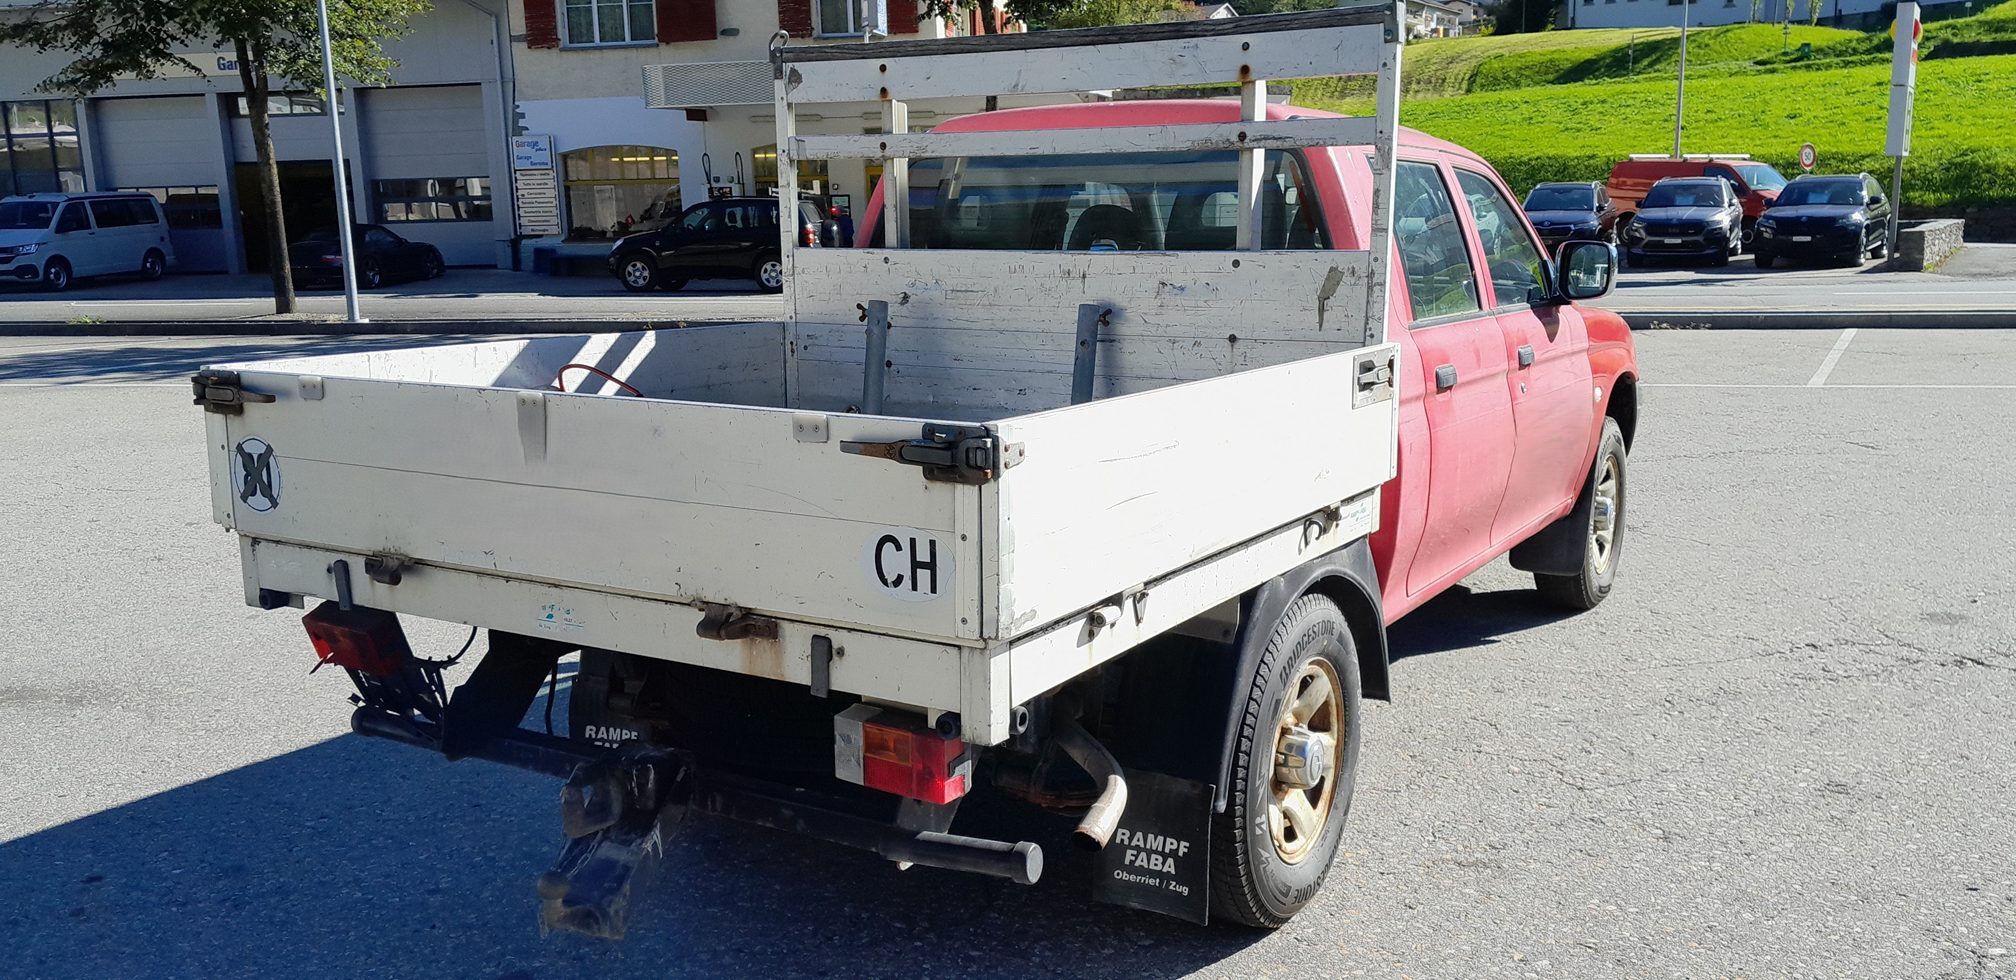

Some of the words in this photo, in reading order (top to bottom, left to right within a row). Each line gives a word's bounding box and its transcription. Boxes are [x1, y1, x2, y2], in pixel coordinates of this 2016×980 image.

[515, 140, 540, 149] Garage
[874, 534, 937, 595] CH
[1279, 620, 1336, 689] BRIDGESTONE
[1115, 828, 1190, 857] RAMPF
[1124, 849, 1176, 875] FABA
[1113, 869, 1160, 887] Oberriet
[1168, 880, 1190, 896] Zug
